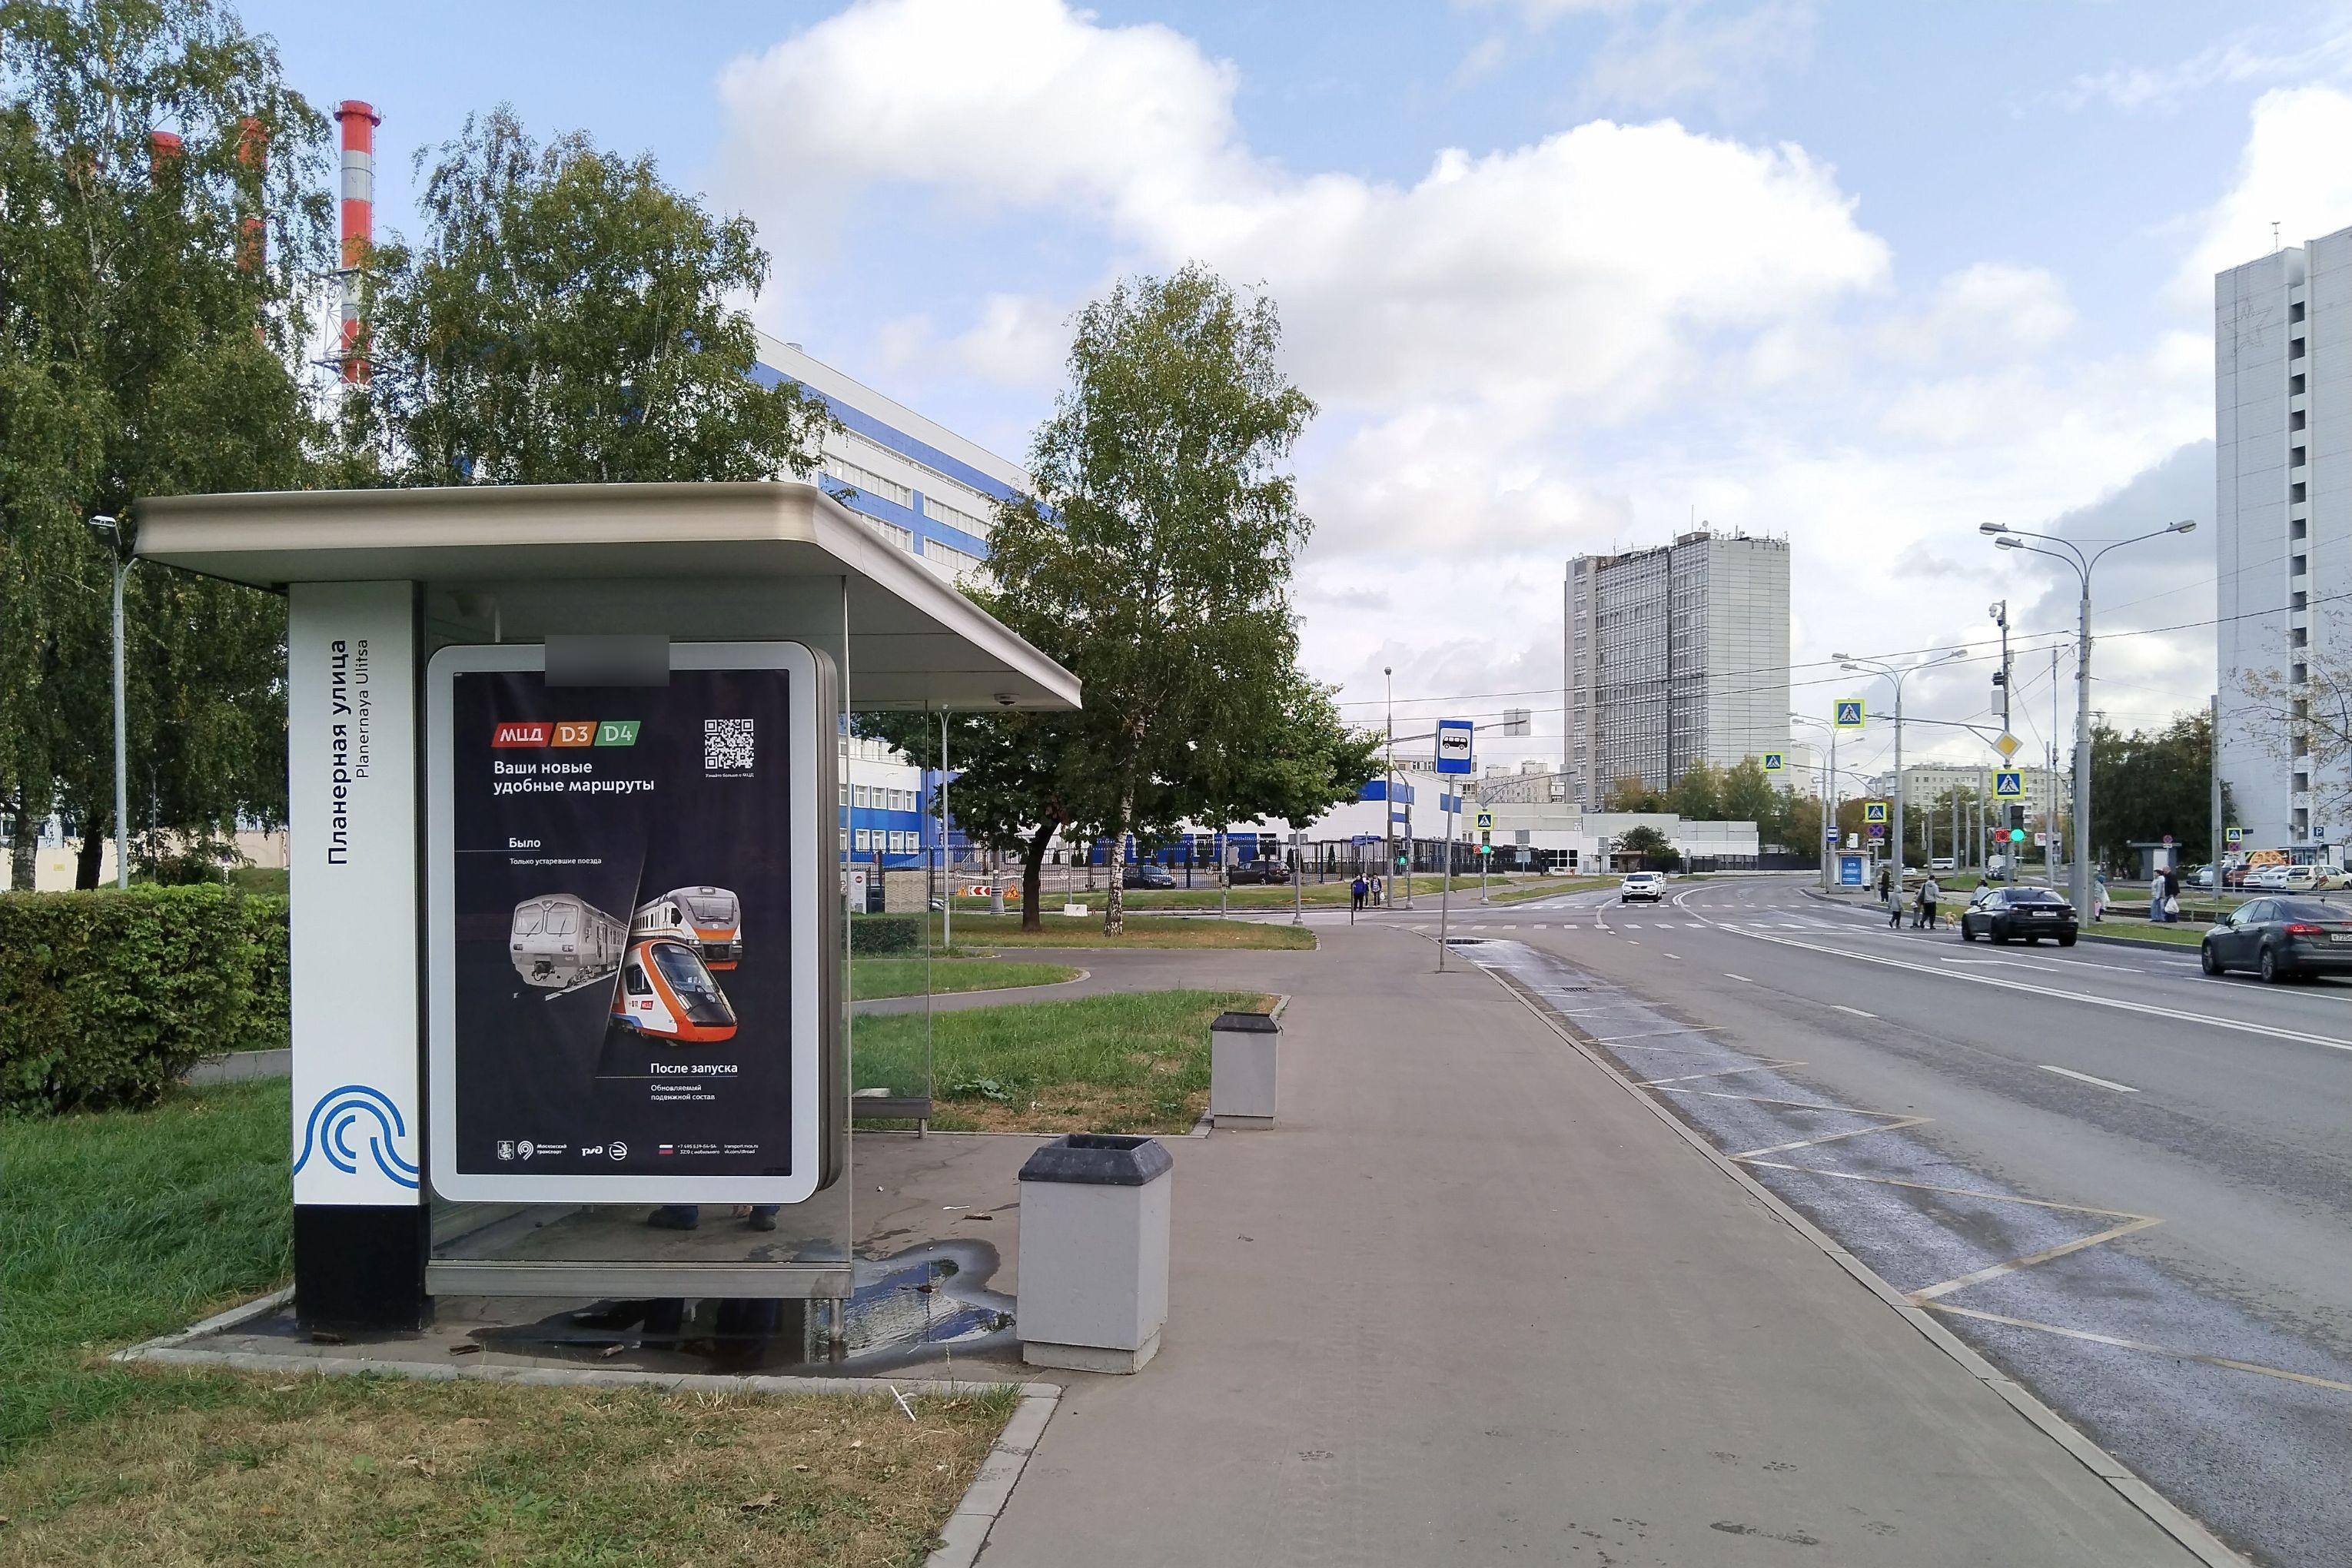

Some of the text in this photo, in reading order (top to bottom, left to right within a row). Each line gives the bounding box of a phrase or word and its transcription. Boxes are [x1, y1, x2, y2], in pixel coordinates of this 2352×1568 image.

[355, 639, 372, 778] Planernaya Ulitsa
[500, 725, 633, 742] МЦД D3 D4
[328, 639, 352, 865] Планерная улица
[494, 761, 593, 774] Ваши новые
[493, 779, 654, 796] удобные маршруты
[509, 837, 541, 849] Было
[535, 858, 576, 866] устаревшие
[650, 1063, 738, 1075] После запуска
[650, 1093, 691, 1101] подвижной
